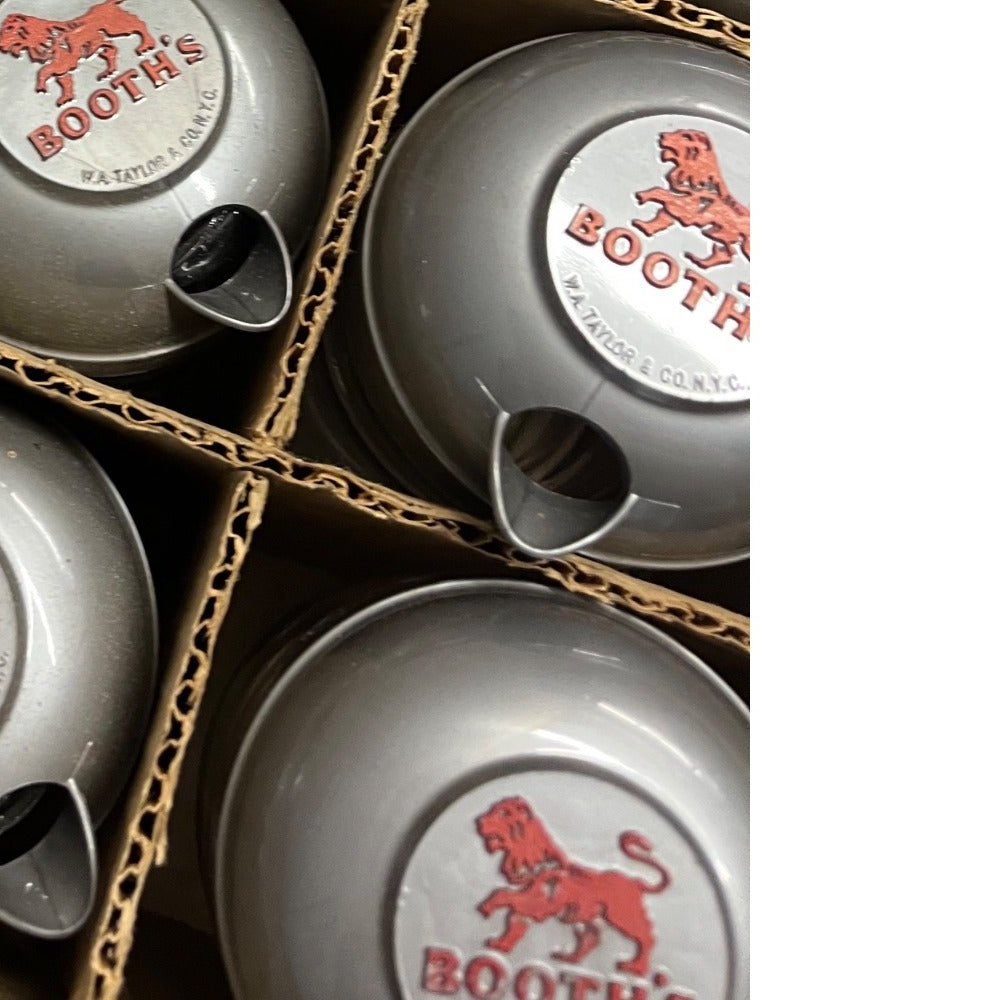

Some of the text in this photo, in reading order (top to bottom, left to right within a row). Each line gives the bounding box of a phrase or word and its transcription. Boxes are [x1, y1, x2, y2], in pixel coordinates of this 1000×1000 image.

[27, 33, 206, 161] BOOTH'S
[583, 307, 638, 365] TAYLOR
[422, 946, 698, 1000] BOOT'
